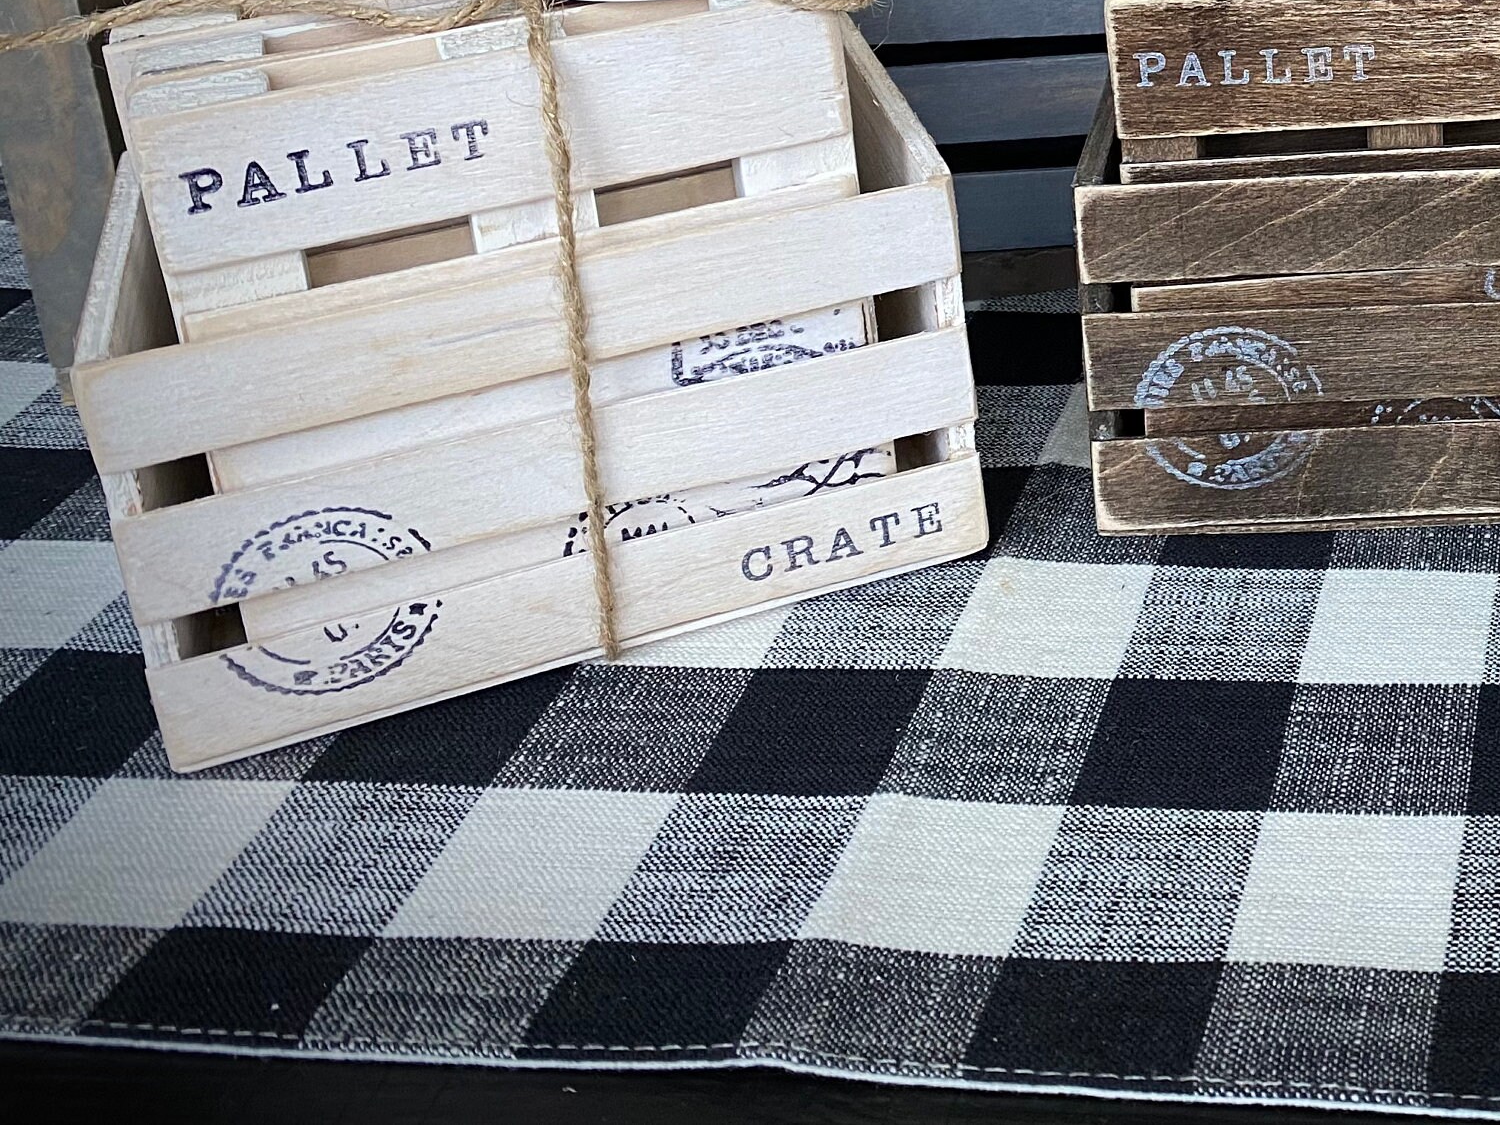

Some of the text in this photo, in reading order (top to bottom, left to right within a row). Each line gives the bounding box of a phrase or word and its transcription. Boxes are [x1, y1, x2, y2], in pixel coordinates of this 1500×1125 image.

[1132, 44, 1375, 88] PALLET
[178, 119, 489, 216] PALLET
[741, 502, 944, 582] CRATE
